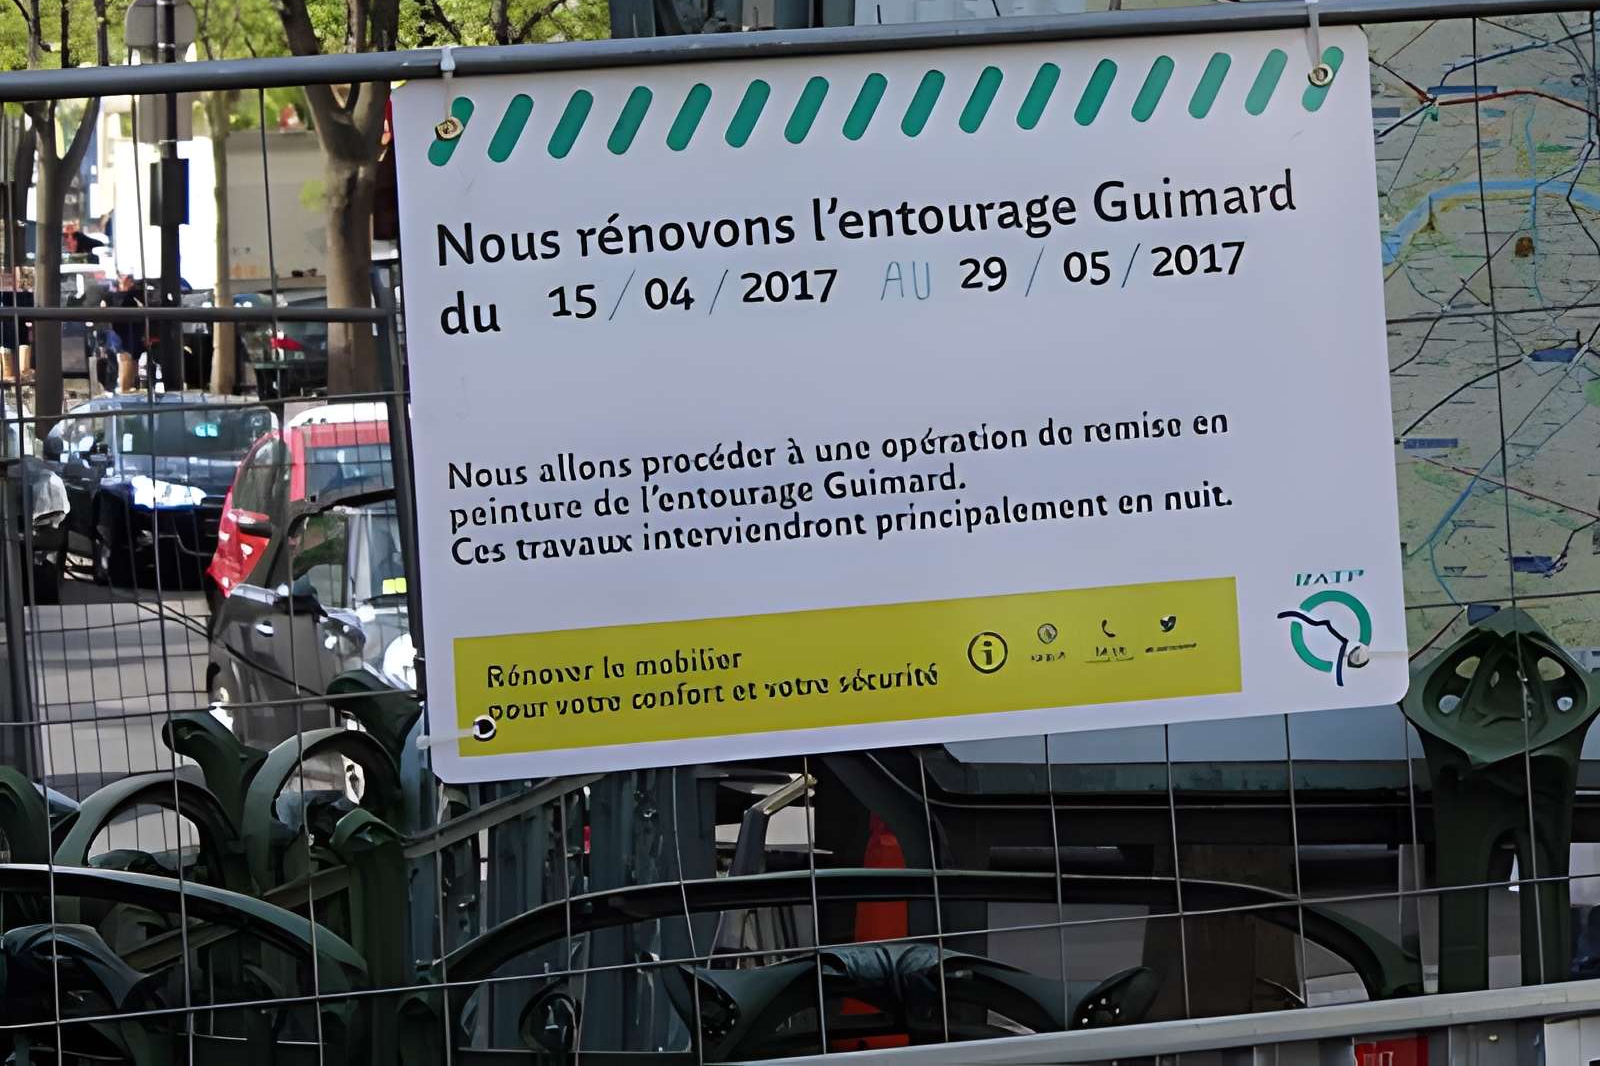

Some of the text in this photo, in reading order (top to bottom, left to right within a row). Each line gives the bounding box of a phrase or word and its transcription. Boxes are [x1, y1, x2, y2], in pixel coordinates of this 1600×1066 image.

[436, 167, 1297, 267] Nous rénovons l'entourage Guimard
[440, 290, 501, 336] du
[548, 283, 597, 319] 15
[644, 276, 696, 311] 04
[740, 268, 839, 303] 2017
[880, 260, 932, 302] AU
[959, 256, 1008, 293] 29
[1063, 250, 1111, 286] 05
[1150, 240, 1246, 277] 2017
[448, 410, 1229, 490] Nous allons procéder à une opération de remise en
[449, 461, 967, 536] peinture de l'entourage Guimard.
[451, 480, 1233, 566] Ces travaux interviendront principalement en nuit.
[486, 701, 549, 724] pour
[555, 695, 622, 716] votre
[632, 681, 725, 710] confort
[732, 682, 758, 702] et
[839, 662, 939, 694] sécurité
[487, 647, 743, 689] Rénover le mobilier
